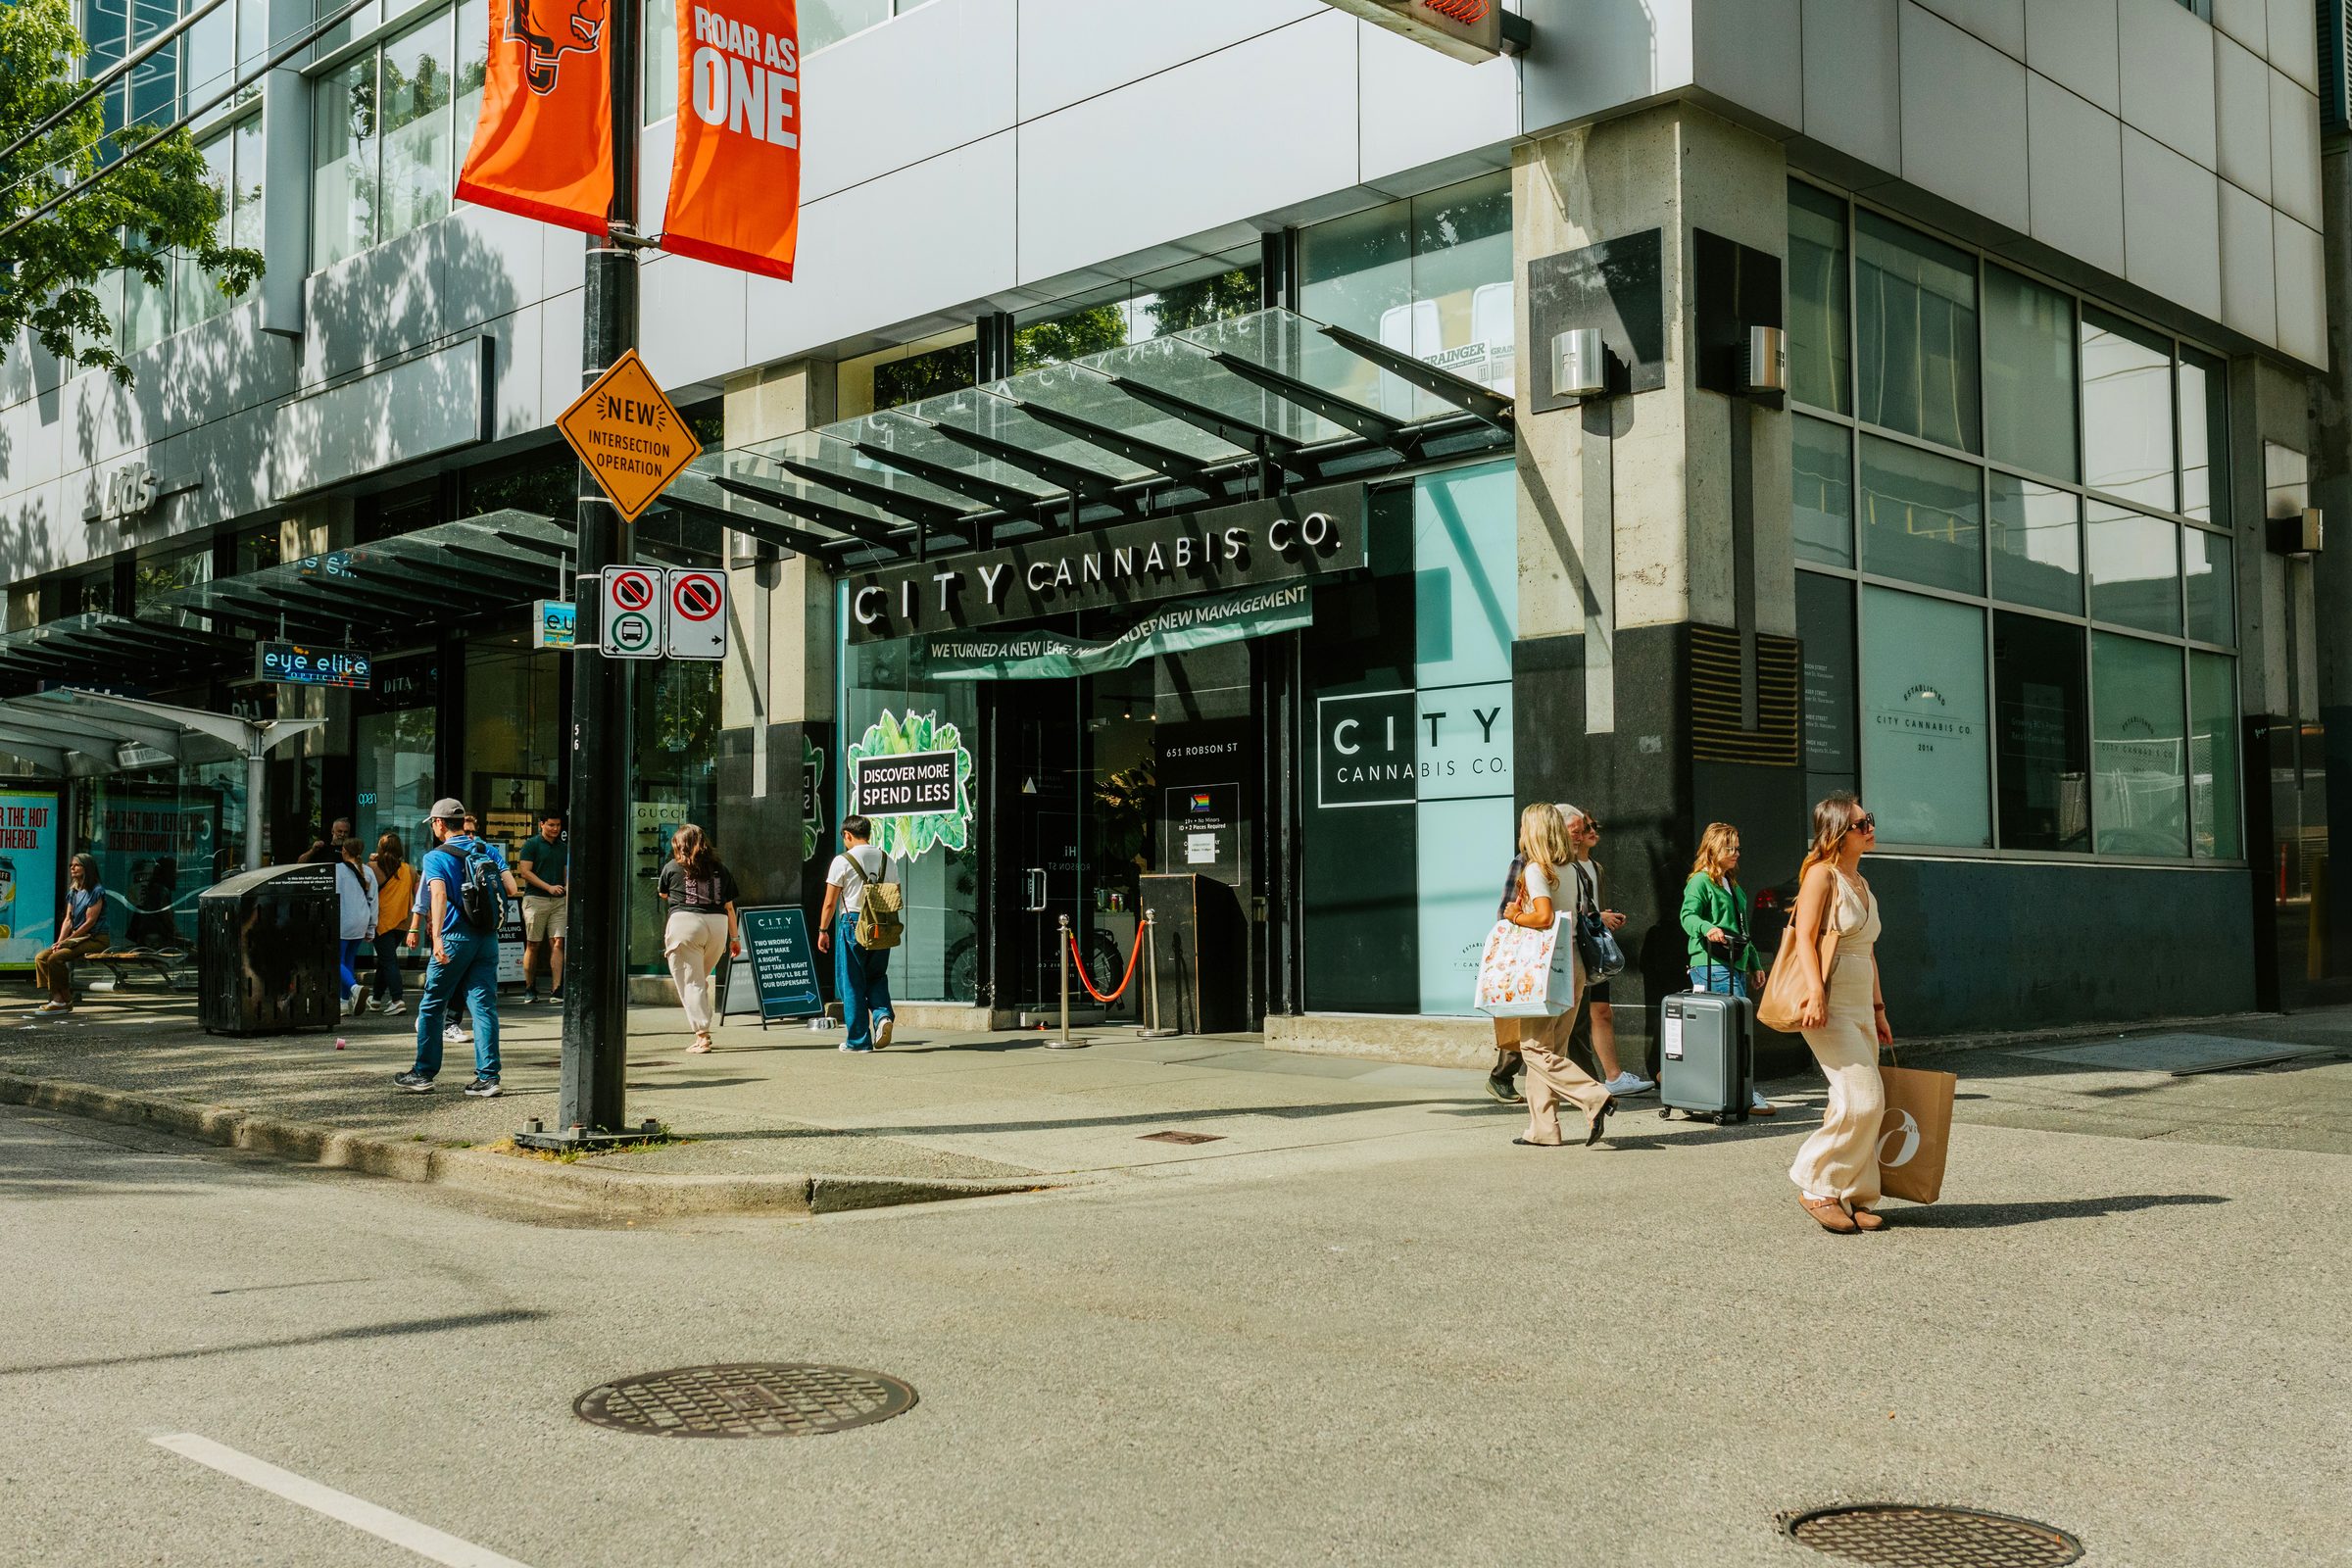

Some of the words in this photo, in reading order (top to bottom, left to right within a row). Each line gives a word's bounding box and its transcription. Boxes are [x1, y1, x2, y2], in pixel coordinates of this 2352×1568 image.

[694, 5, 761, 64] ROAR
[764, 32, 797, 74] AS
[692, 46, 798, 150] ONE
[608, 395, 655, 427] NEW
[588, 429, 670, 458] INTERSECTION
[596, 453, 662, 478] OPERATION
[101, 462, 157, 522] Lids
[854, 563, 1004, 625] CITY
[1027, 527, 1241, 591] CANNABIS
[1268, 512, 1343, 552] CO.
[546, 614, 575, 636] ey
[931, 643, 950, 658] WE
[951, 643, 998, 658] TURNED
[998, 643, 1008, 657] A
[1010, 641, 1041, 657] NEW
[1158, 609, 1194, 630] NEW
[1196, 585, 1308, 625] MANAGEMENT
[265, 653, 308, 673] eye
[317, 654, 368, 675] elite
[384, 676, 412, 694] DITA
[1333, 707, 1502, 756] CITY
[1876, 716, 1899, 725] CITY
[1905, 719, 1953, 732] CANNABIS
[1166, 748, 1182, 758] 651
[1186, 745, 1223, 756] ROBSON
[1227, 743, 1238, 752] ST
[864, 766, 916, 784] DISCOVER
[917, 764, 950, 779] MORE
[1337, 760, 1456, 783] CANNABIS
[1472, 757, 1507, 774] CO.
[358, 792, 377, 807] open
[863, 786, 911, 806] SPEND
[916, 783, 951, 802] LESS
[7, 807, 26, 827] THE
[28, 808, 49, 827] HOT
[637, 808, 685, 819] GUCCI
[758, 917, 792, 926] CITY
[776, 979, 811, 987] DISPENSARY.
